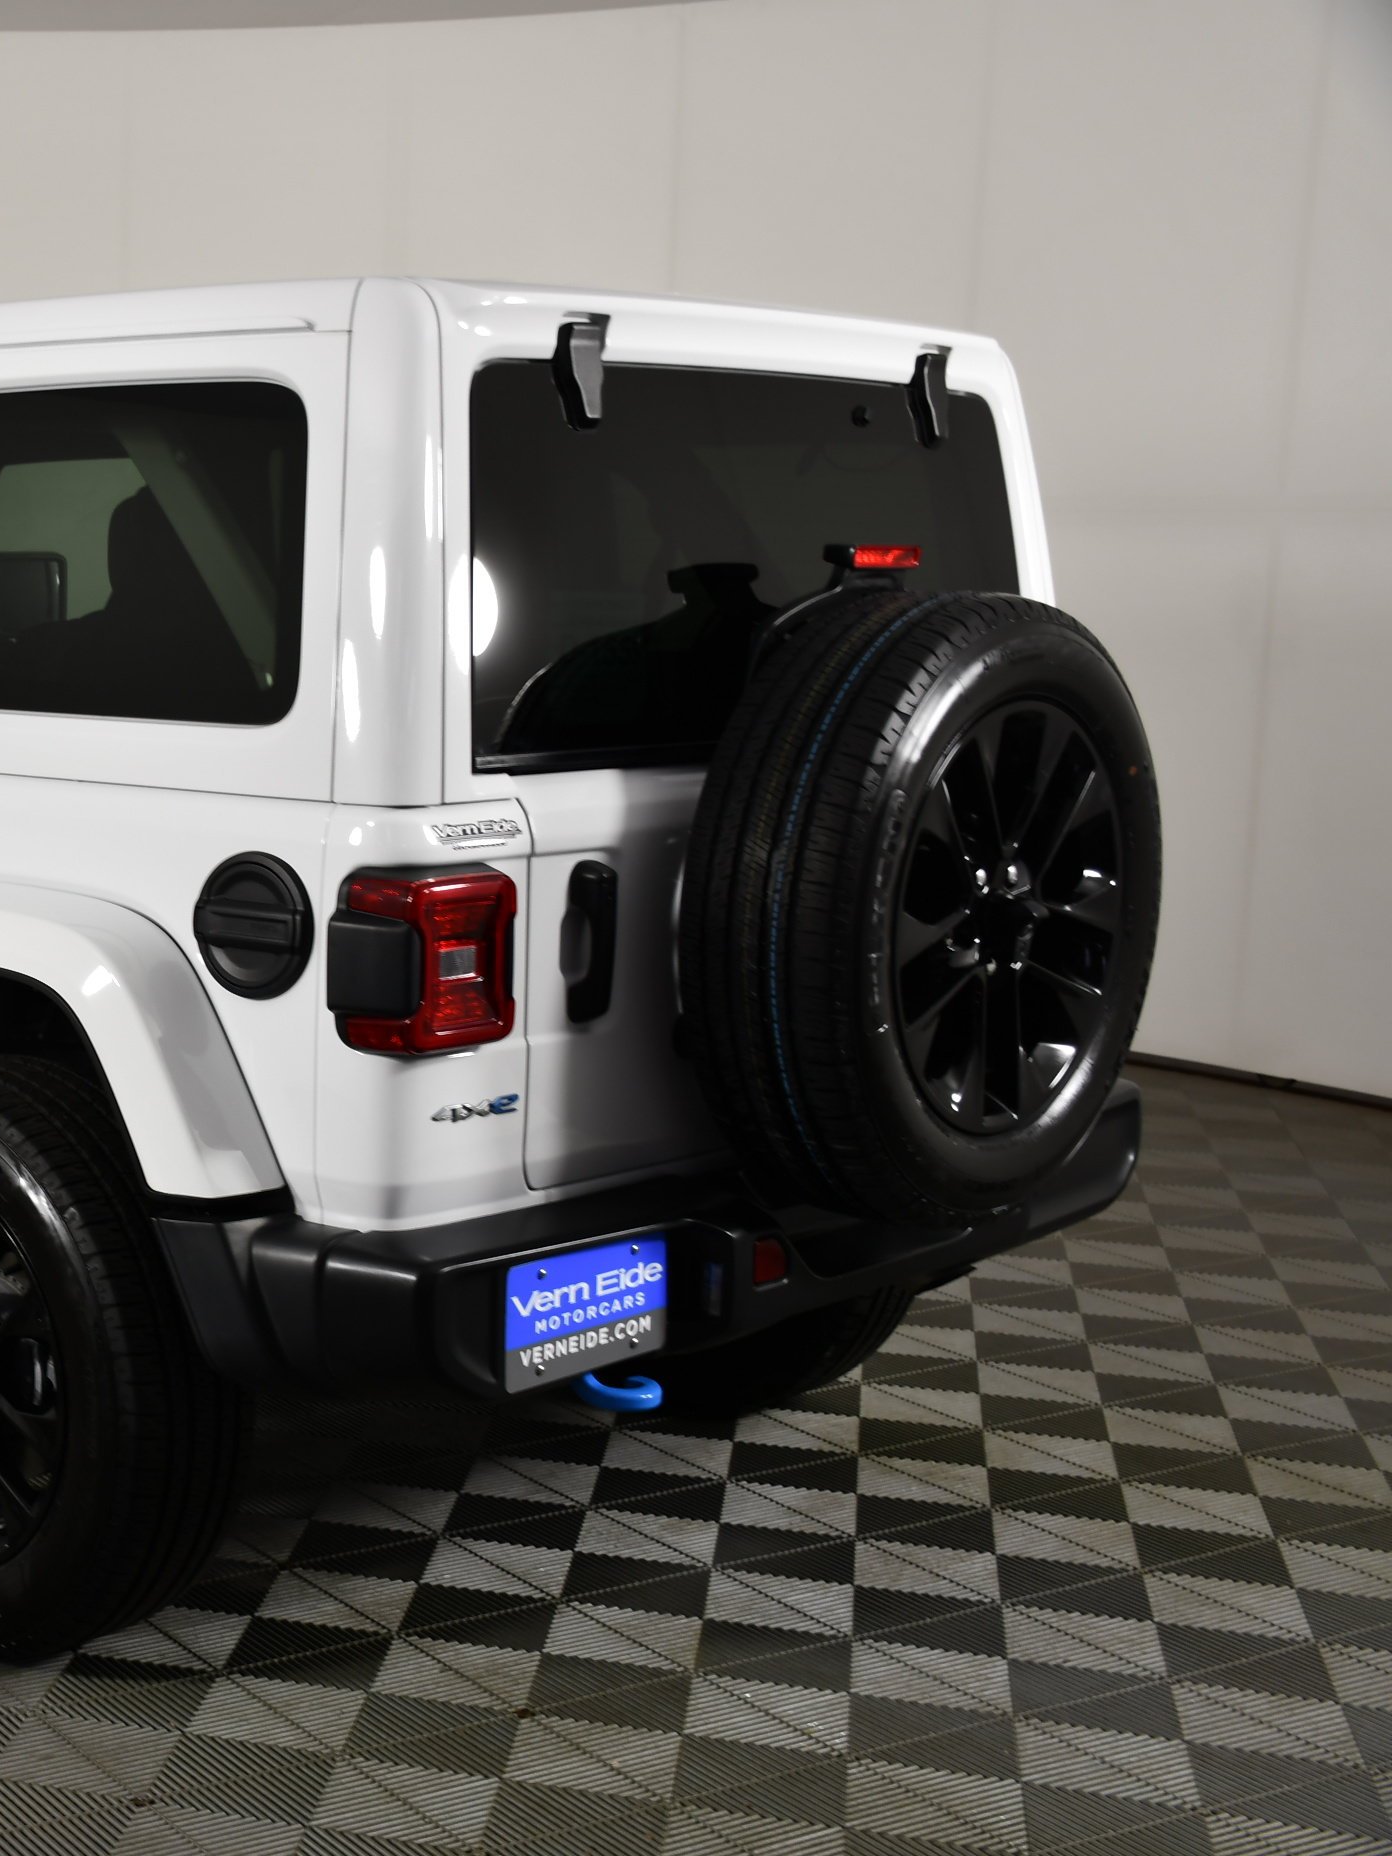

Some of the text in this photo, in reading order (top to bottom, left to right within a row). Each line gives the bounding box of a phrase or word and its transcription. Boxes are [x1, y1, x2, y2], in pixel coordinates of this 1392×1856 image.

[510, 1261, 663, 1317] Vern Eide
[534, 1291, 645, 1334] MOTORCARS
[519, 1314, 652, 1367] VERNEIDE.COM
